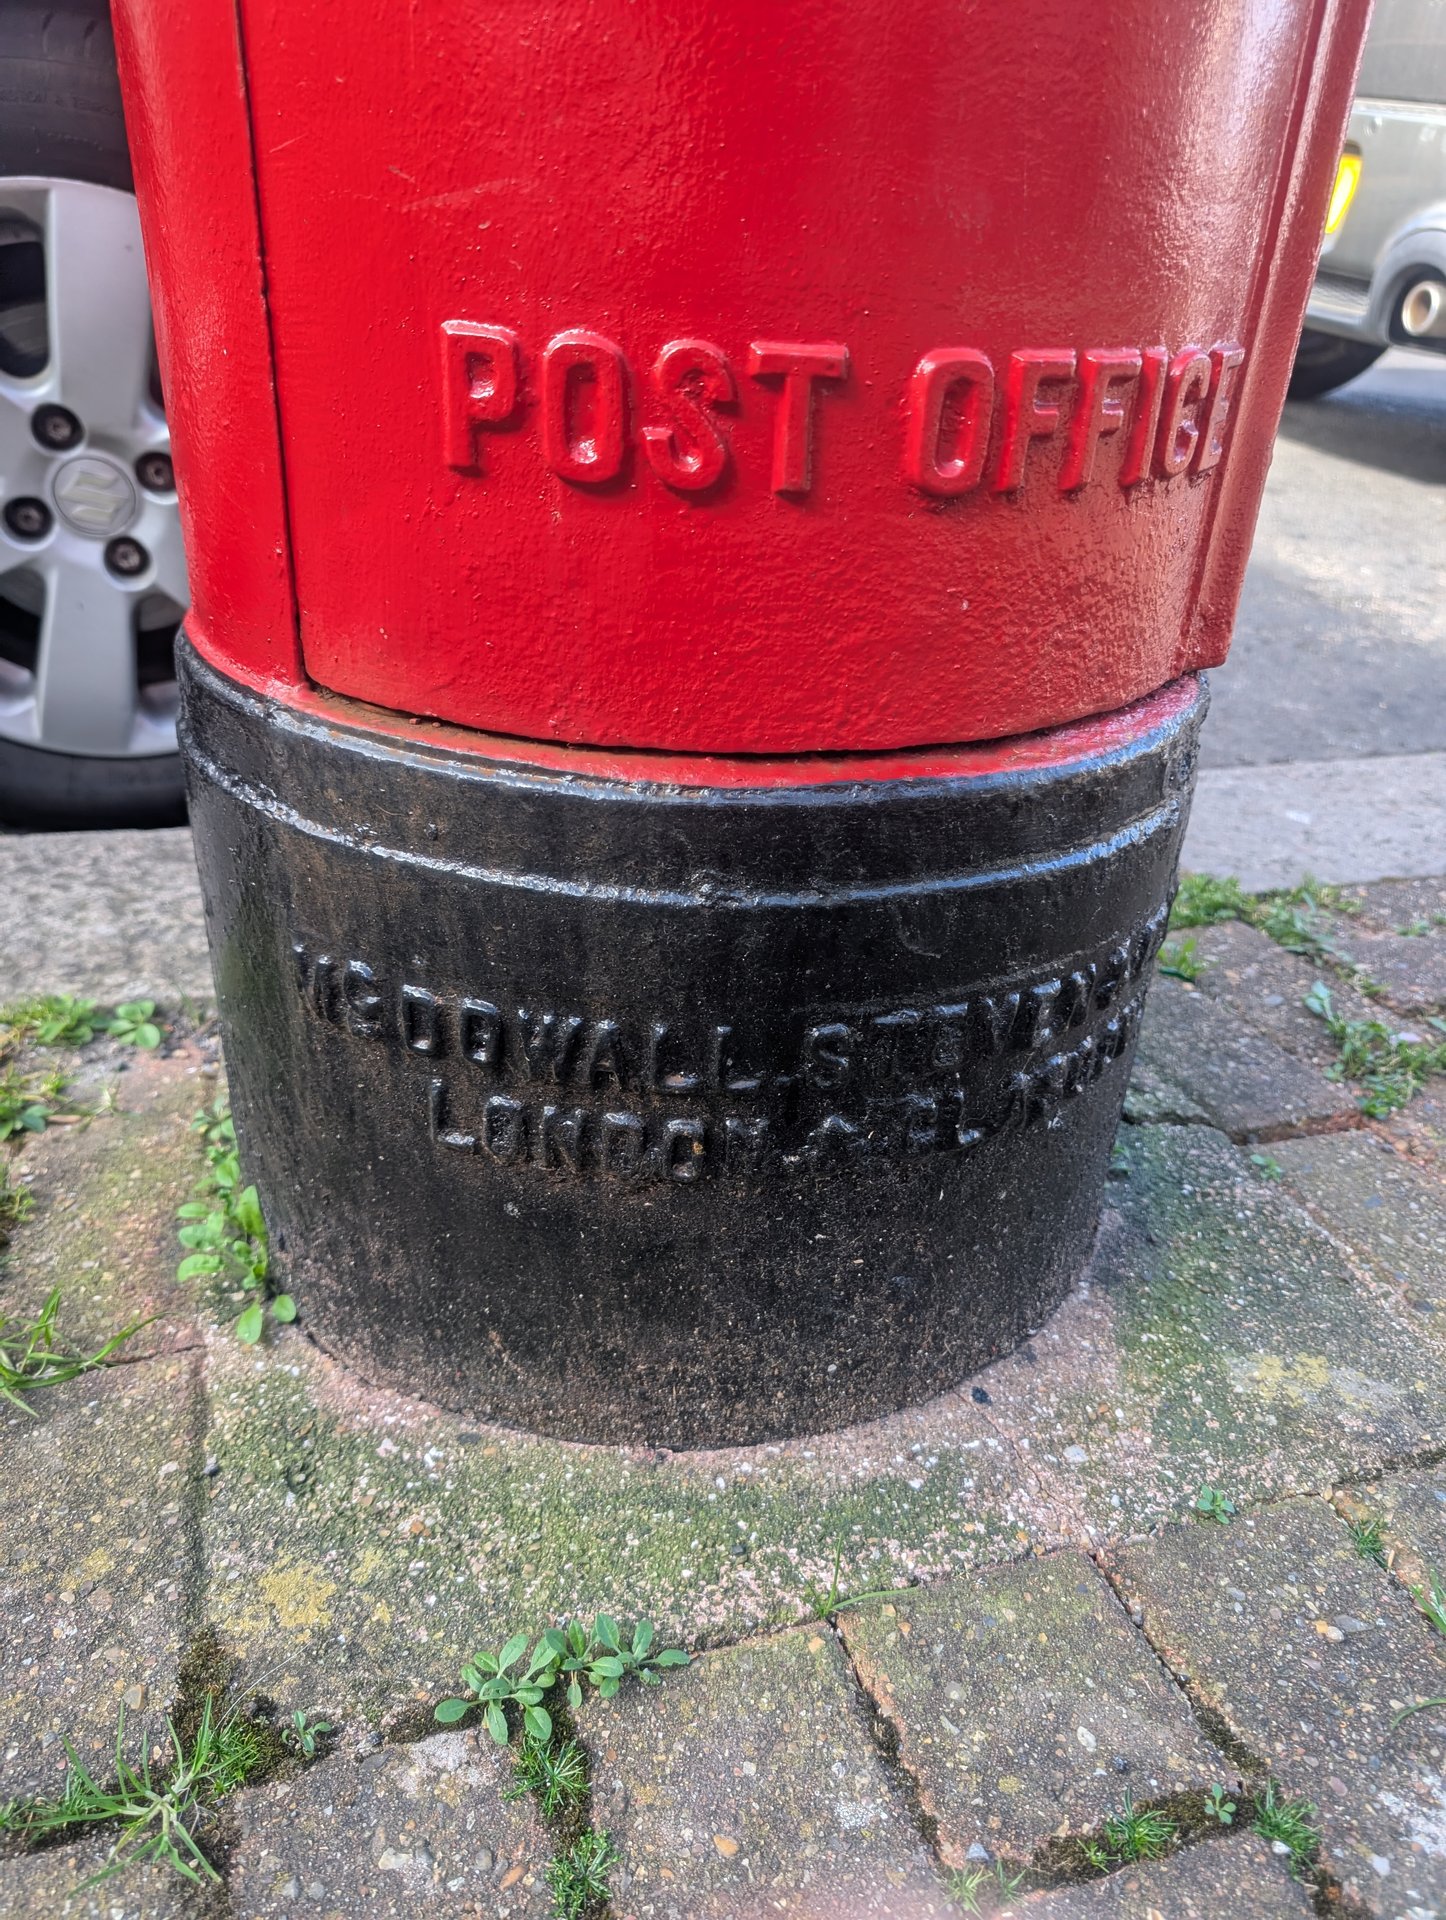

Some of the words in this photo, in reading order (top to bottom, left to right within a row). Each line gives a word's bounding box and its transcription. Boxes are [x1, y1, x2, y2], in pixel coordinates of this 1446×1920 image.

[439, 317, 849, 494] POST
[904, 343, 1246, 498] OFFICE
[426, 1076, 770, 1183] LONDON
